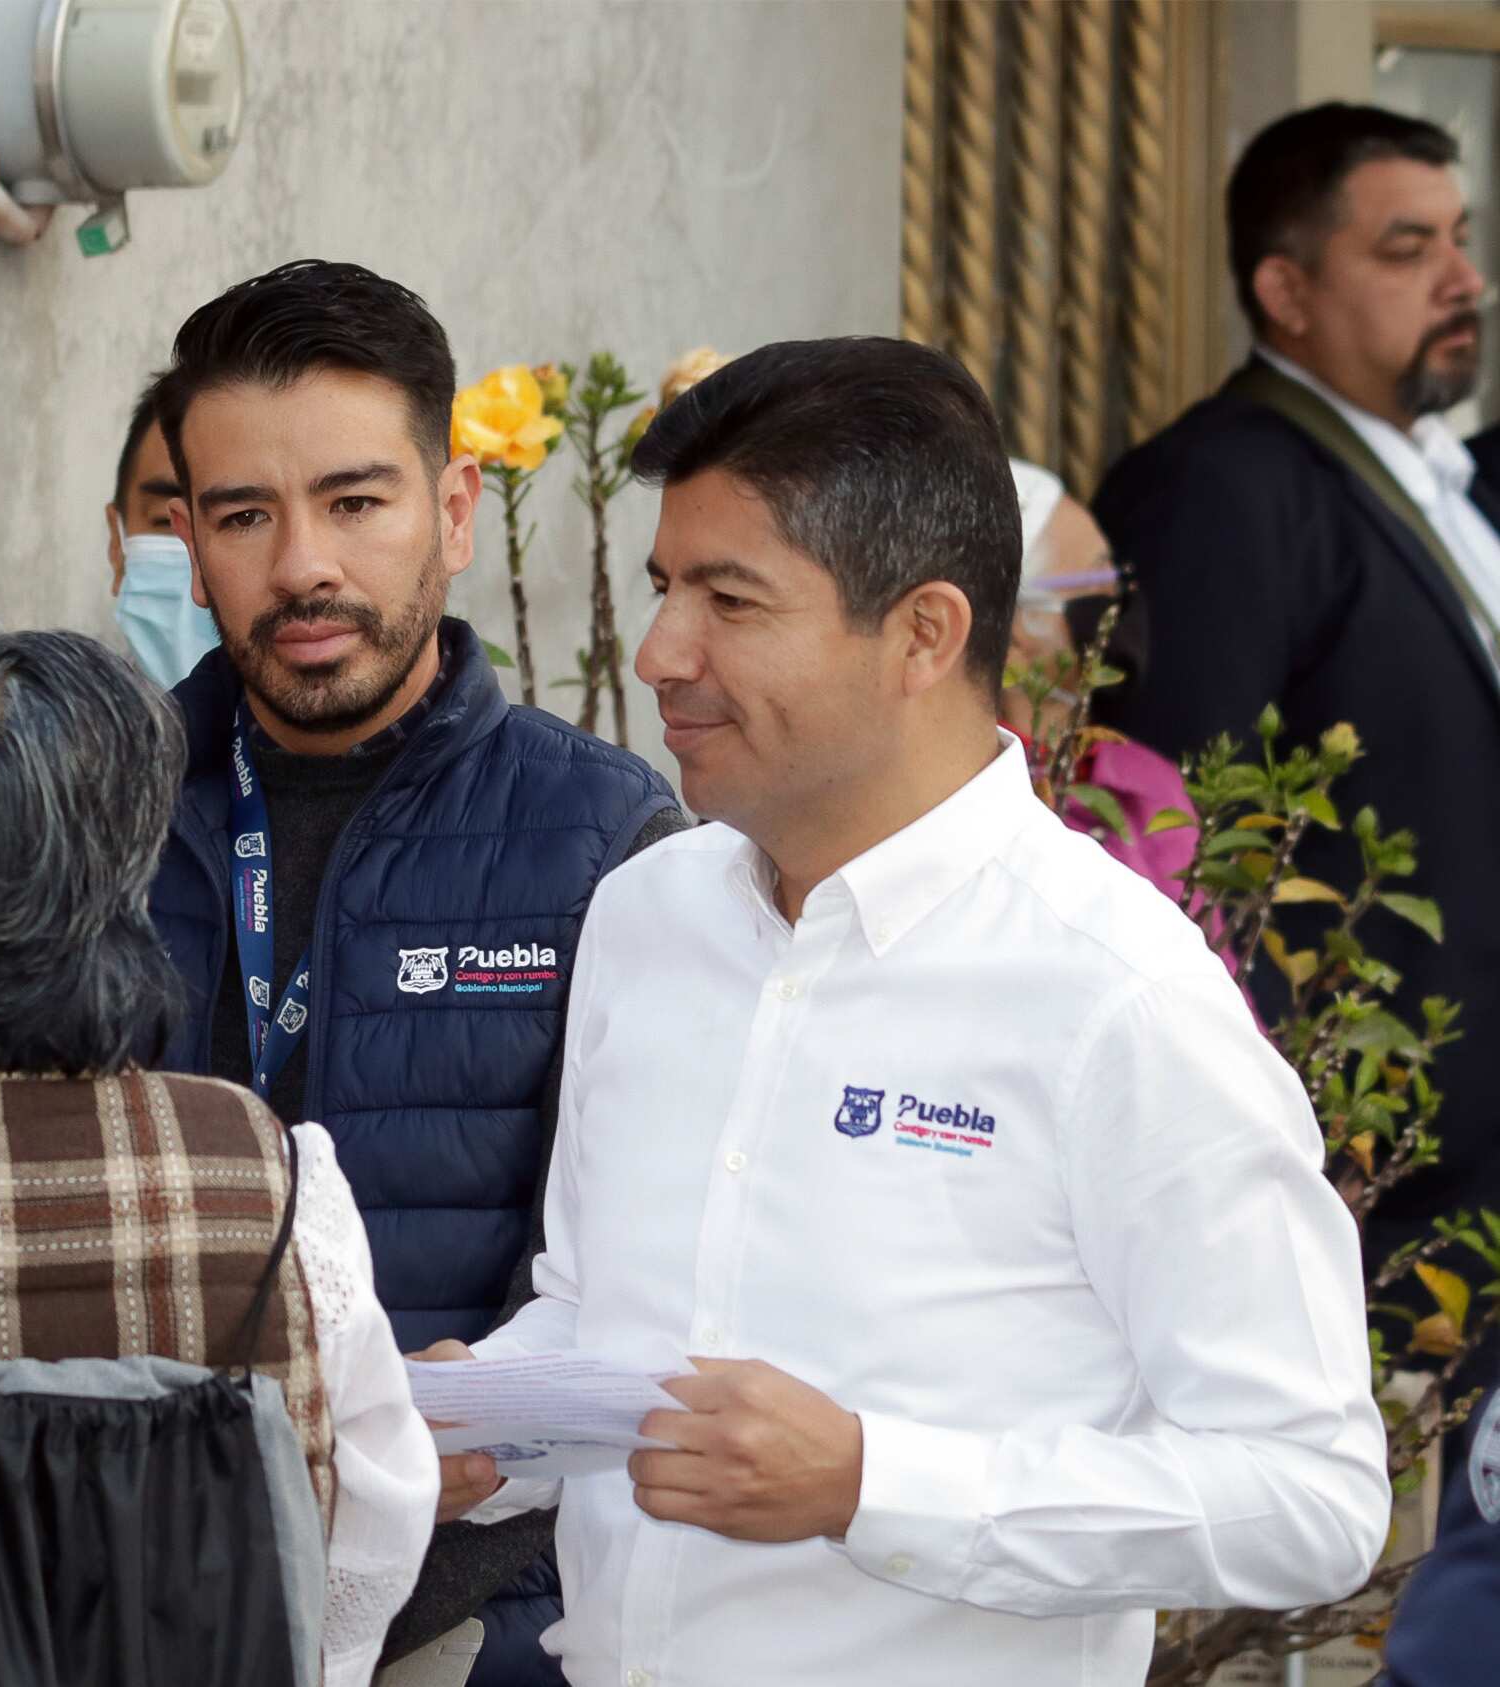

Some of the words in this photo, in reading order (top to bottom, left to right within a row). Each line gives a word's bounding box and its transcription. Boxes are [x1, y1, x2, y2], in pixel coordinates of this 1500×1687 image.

[232, 736, 253, 797] Puebla
[252, 869, 269, 933] Puebla
[457, 942, 556, 968] Puebla
[455, 970, 495, 984] Contigo
[503, 971, 522, 981] con
[897, 1093, 995, 1134] Puebla
